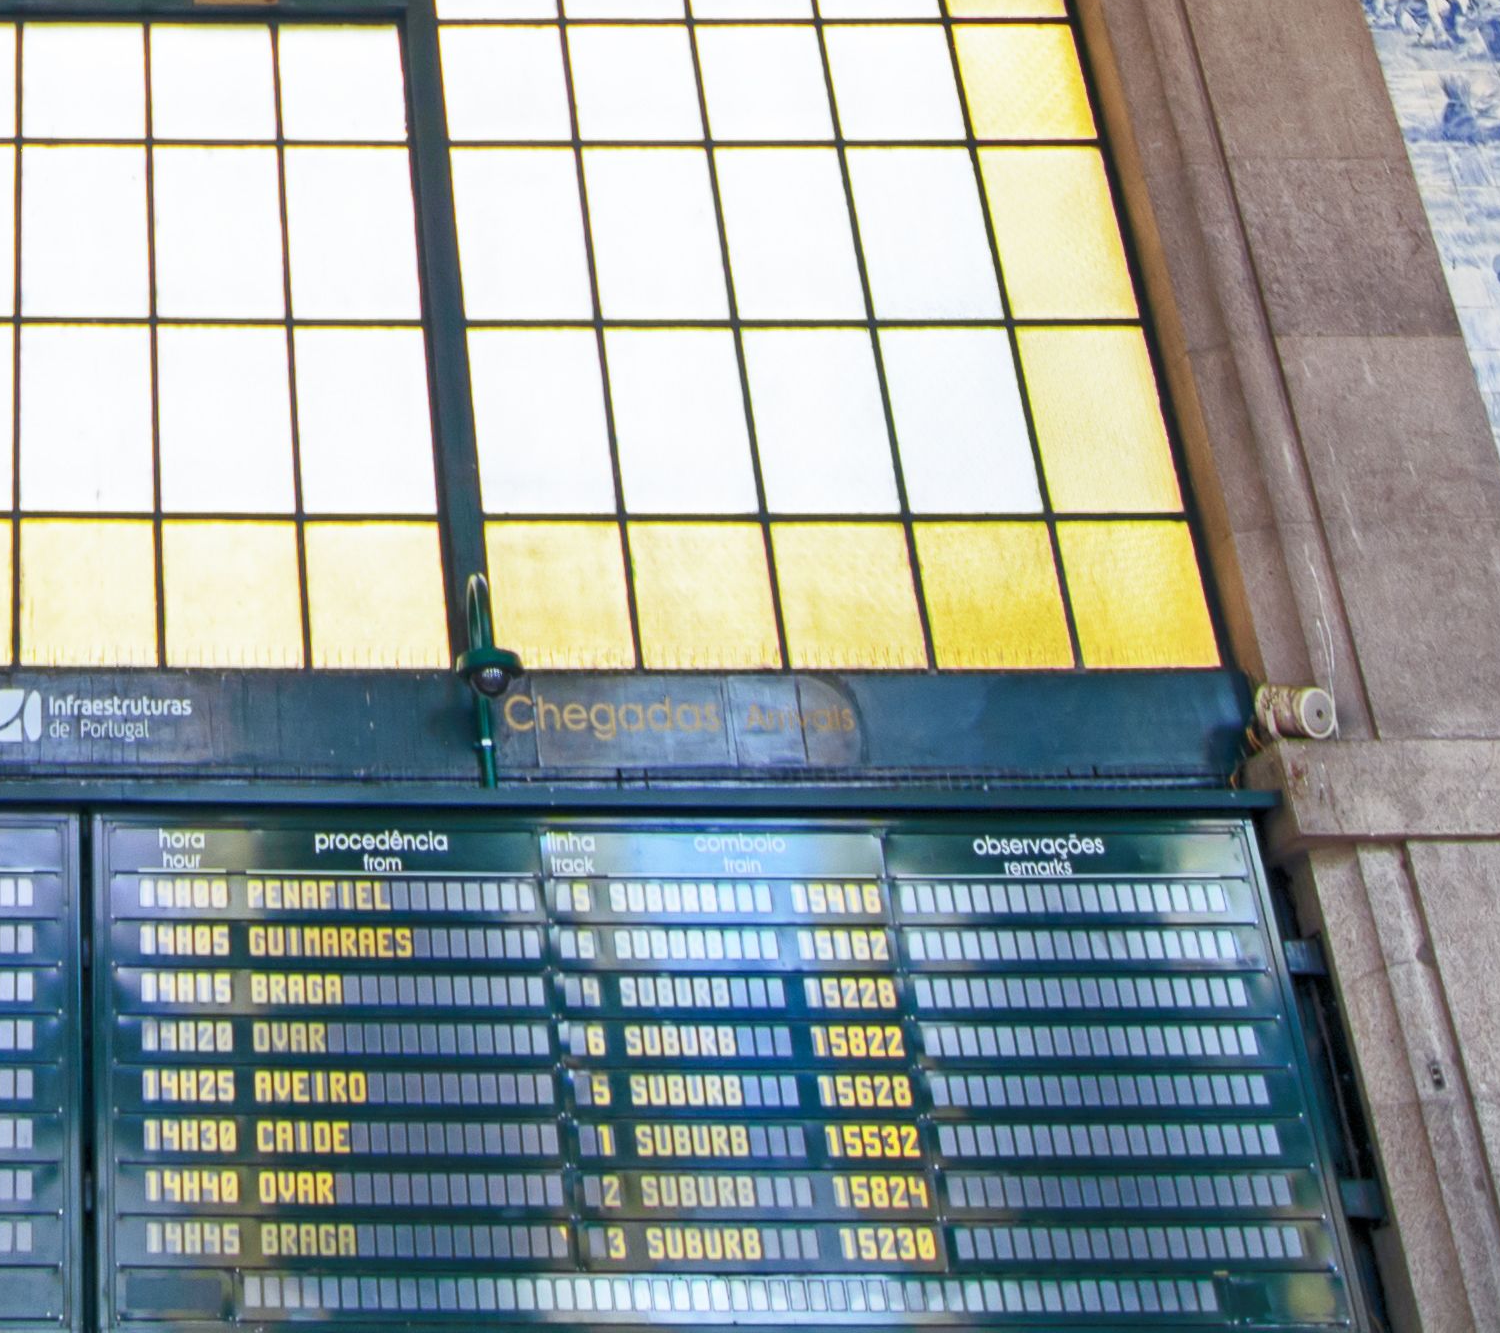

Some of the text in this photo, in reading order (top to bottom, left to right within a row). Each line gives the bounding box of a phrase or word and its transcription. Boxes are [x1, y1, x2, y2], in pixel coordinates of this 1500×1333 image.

[49, 696, 192, 717] Infraestruturas
[504, 694, 857, 741] Chegadas Arrivals
[49, 720, 149, 743] de Portugal
[159, 829, 1105, 858] hora procedência linha comboio observações
[163, 852, 1073, 877] hour from track train remarks
[140, 879, 229, 908] 14H00
[248, 880, 391, 910] PENAFIEL
[573, 884, 591, 912] 5
[791, 884, 881, 914] 15416
[140, 925, 229, 956] 14H05
[249, 927, 413, 957] GUIMARAES
[798, 931, 889, 961] 15162
[142, 973, 231, 1003] 14H15
[251, 974, 342, 1004] BRAGA
[620, 978, 730, 1007] SUBURB
[806, 979, 897, 1008] 15228
[143, 1021, 905, 1057] 14H20 OVAR 6 SUBURB 15822
[143, 1069, 913, 1107] 14H25 AVEIRO 5 SUBURB 15628
[145, 1120, 921, 1157] 14H30 CAIDE 1 SUBURB 15532
[146, 1171, 929, 1208] 14H40 OVAR 2 SUBURB 15824
[147, 1223, 936, 1259] 14H45 BRAGA 3 SUBURB 15230
